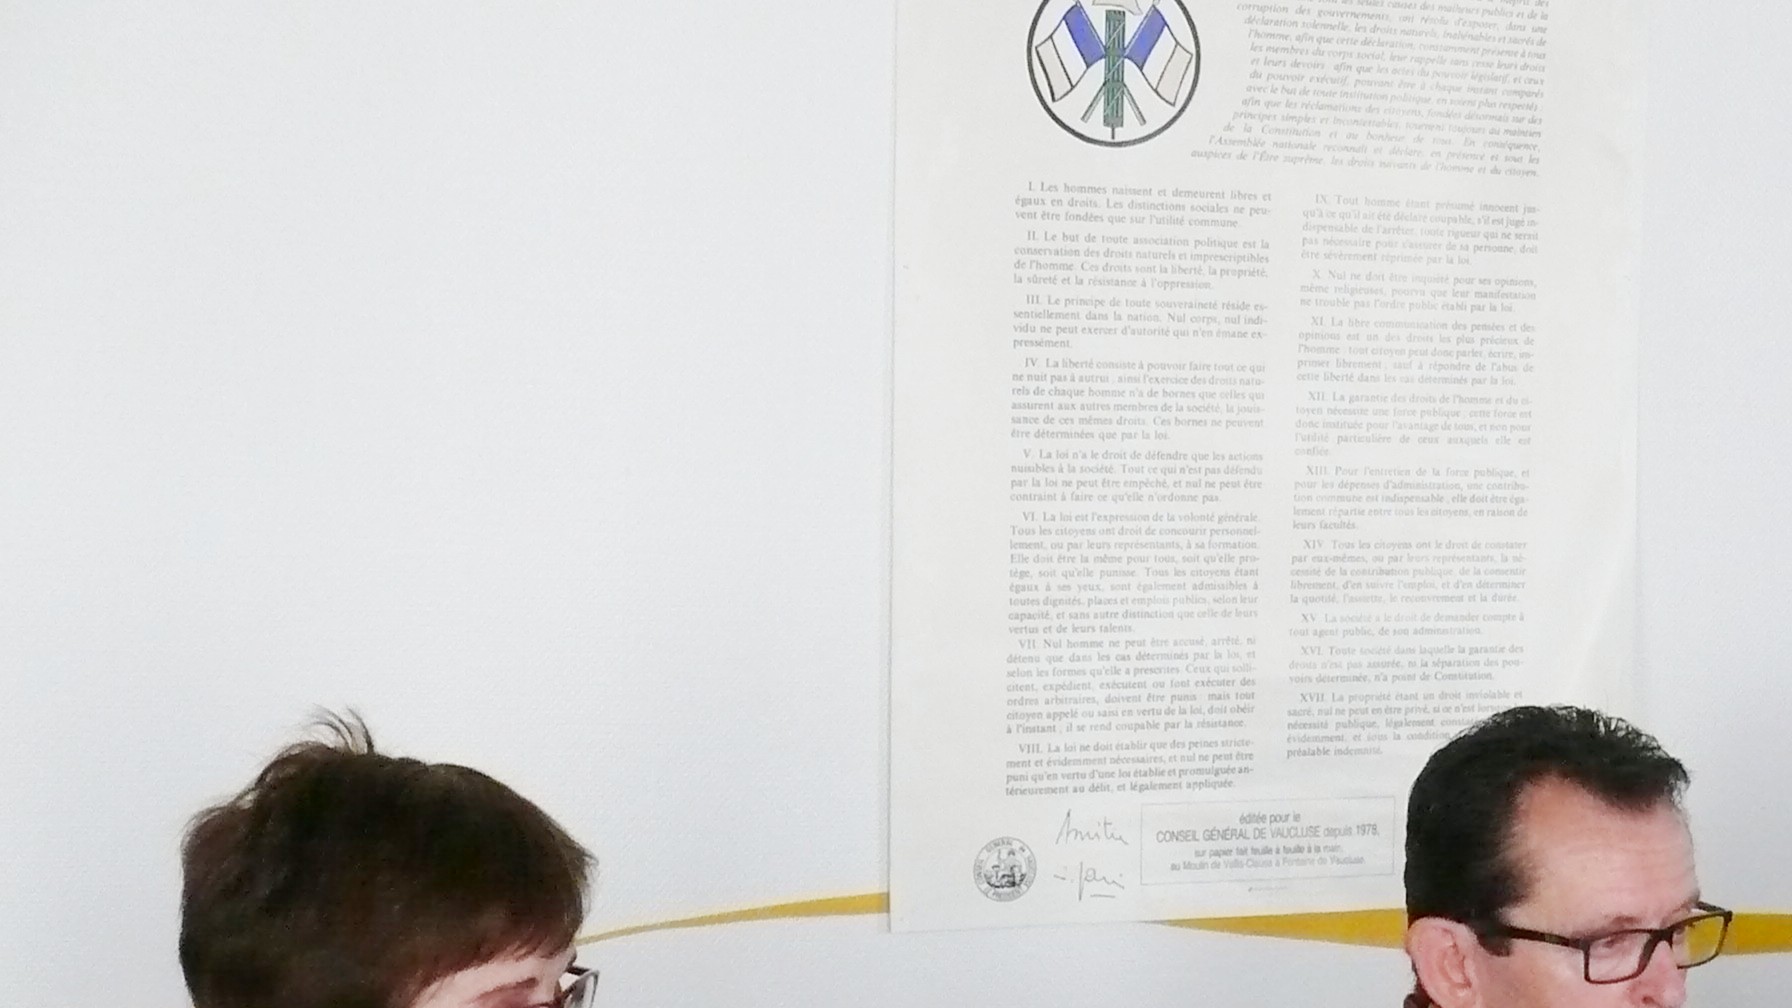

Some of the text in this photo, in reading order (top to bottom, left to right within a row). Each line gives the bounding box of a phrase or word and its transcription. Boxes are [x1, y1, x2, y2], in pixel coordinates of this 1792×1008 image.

[1040, 182, 1058, 193] Les
[1063, 182, 1106, 195] hommes
[1112, 184, 1152, 197] naissent
[1157, 186, 1166, 197] et
[1171, 187, 1225, 200] demeurent
[1230, 189, 1257, 201] libres
[1262, 191, 1271, 202] et
[1014, 195, 1045, 210] égaux
[1050, 199, 1062, 207] en
[1106, 199, 1123, 210] Les
[1127, 199, 1185, 212] distinctions
[1190, 202, 1228, 214] sociales
[1233, 206, 1244, 214] ne
[1249, 207, 1270, 218] peu-
[1014, 209, 1036, 220] vent
[1040, 210, 1060, 221] être
[1064, 211, 1103, 223] fondées
[1107, 215, 1125, 226] que
[1130, 216, 1144, 224] sur
[1149, 214, 1184, 226] l'utilité
[1044, 231, 1056, 242] Le
[1062, 231, 1079, 243] but
[1084, 232, 1096, 243] de
[1101, 233, 1127, 244] toute
[1133, 234, 1189, 246] association
[1193, 236, 1237, 251] politique
[1242, 238, 1256, 249] est
[1260, 238, 1269, 249] la
[1013, 244, 1269, 266] conservation des droits naturels et imprescriptibles
[1013, 259, 1026, 269] de
[1080, 261, 1098, 272] Ces
[1101, 261, 1131, 273] droits
[1135, 263, 1155, 274] sont
[1159, 263, 1167, 274] la
[1208, 265, 1217, 276] la
[1013, 273, 1022, 284] la
[1026, 273, 1057, 285] sûreté
[1061, 274, 1070, 285] et
[1074, 275, 1083, 286] la
[1088, 275, 1136, 287] résistance
[1141, 277, 1146, 288] à
[1047, 295, 1060, 305] Le
[1064, 295, 1104, 310] principe
[1109, 296, 1120, 307] de
[1125, 297, 1150, 308] toute
[1155, 297, 1217, 309] souveraineté
[1221, 299, 1250, 310] réside
[1013, 308, 1079, 321] sentiellement
[1085, 310, 1108, 321] dans
[1113, 311, 1121, 322] la
[1167, 312, 1185, 323] Nul
[1224, 313, 1240, 324] nul
[1331, 316, 1343, 327] La
[1348, 317, 1369, 328] libre
[1374, 317, 1447, 329] communication
[1451, 319, 1467, 330] des
[1470, 319, 1504, 334] pensées
[1508, 320, 1516, 331] et
[1520, 320, 1535, 331] des
[1047, 742, 1060, 753] La
[1064, 742, 1076, 753] loi
[1079, 744, 1090, 752] ne
[1093, 741, 1112, 752] doit
[1115, 740, 1146, 751] établir
[1149, 742, 1166, 753] que
[1169, 739, 1185, 750] des
[1188, 738, 1218, 752] peines
[1005, 757, 1031, 768] ment
[1034, 756, 1043, 767] et
[1046, 754, 1106, 767] évidemment
[1168, 752, 1176, 763] et
[1180, 752, 1195, 763] nul
[1198, 754, 1208, 762] ne
[1212, 751, 1232, 765] peut
[1235, 750, 1254, 761] être
[1238, 812, 1301, 826] éditée pour le
[1155, 831, 1198, 843] CONSEIL
[1202, 826, 1248, 841] GÉNÉRAL
[1253, 829, 1266, 840] DE
[1270, 827, 1319, 839] VAUCLUSE
[1323, 826, 1352, 840] depuis
